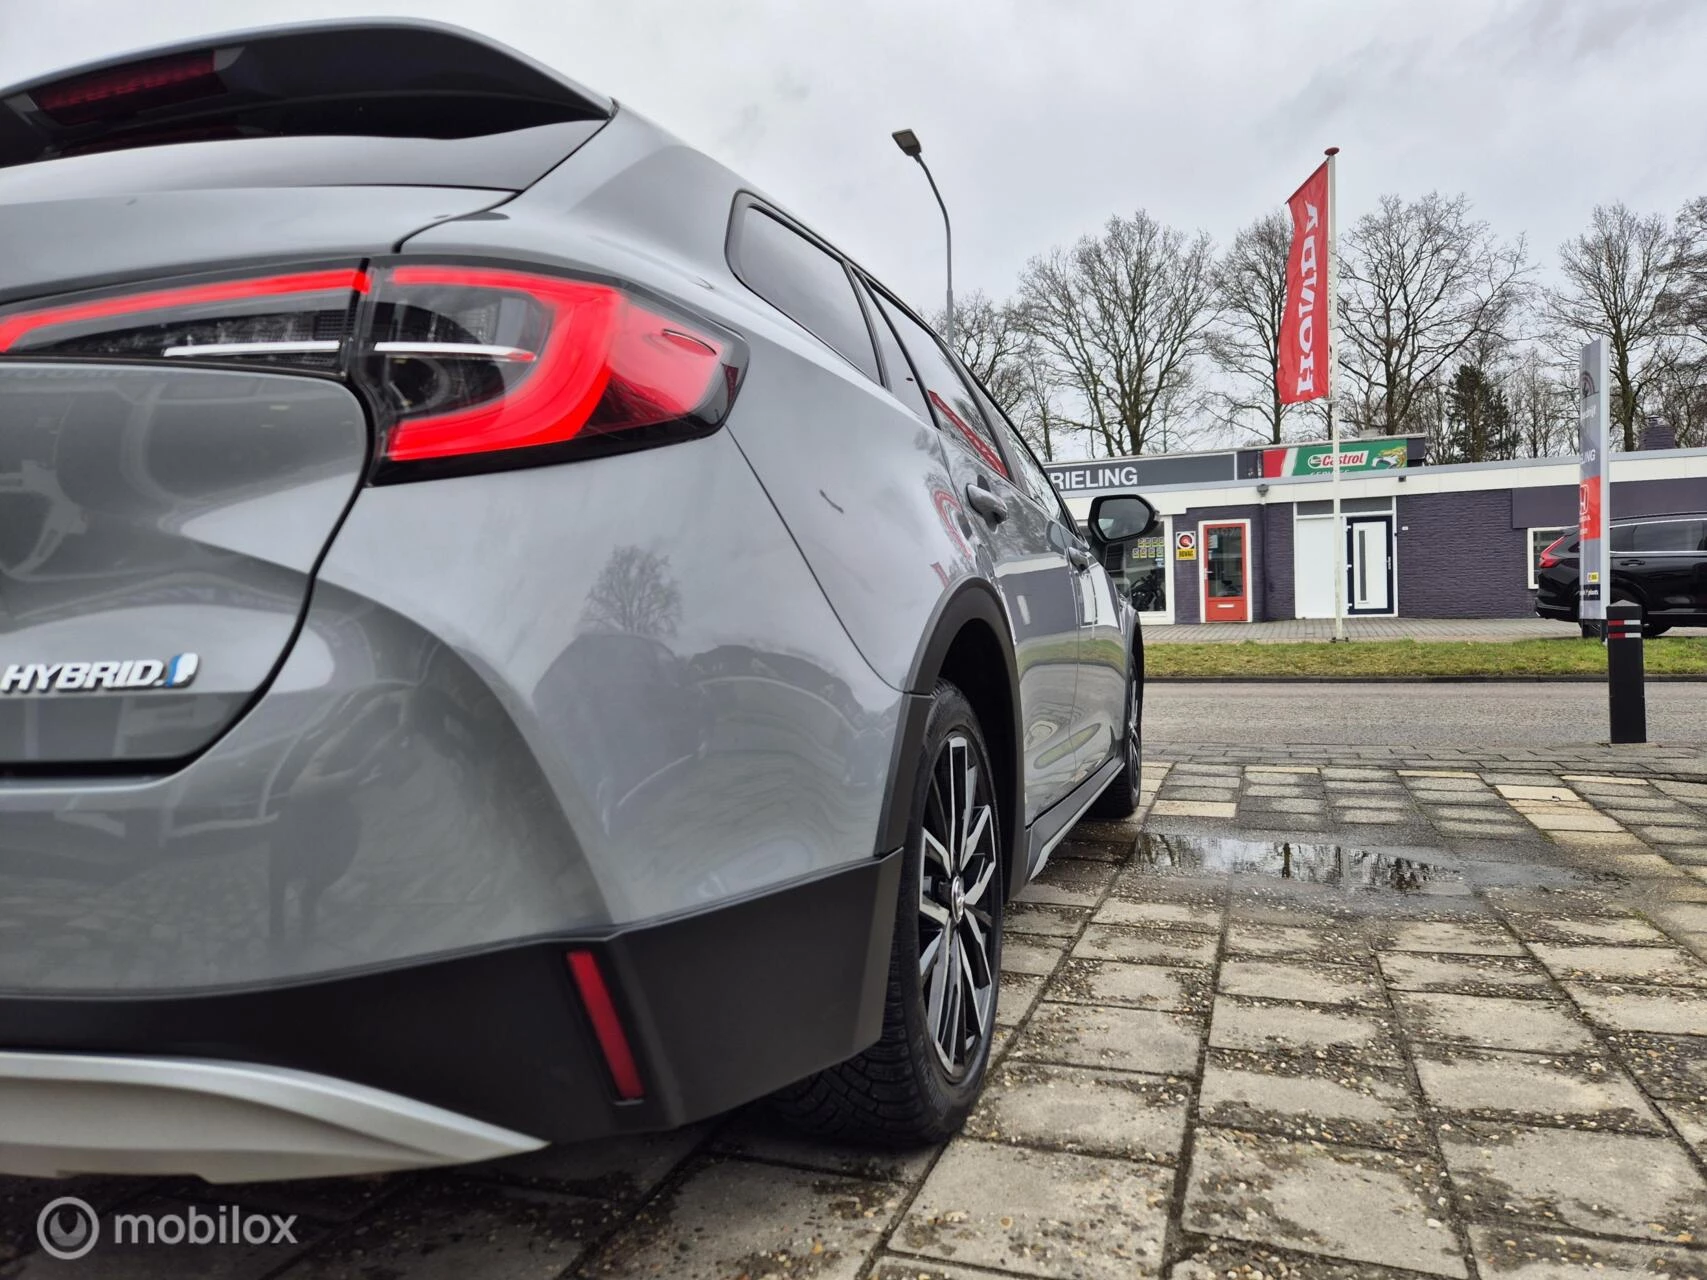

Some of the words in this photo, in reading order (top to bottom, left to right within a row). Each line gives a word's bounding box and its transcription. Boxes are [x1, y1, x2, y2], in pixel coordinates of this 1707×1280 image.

[1297, 201, 1318, 394] HONDA
[1048, 466, 1138, 490] RIELING
[1, 660, 164, 692] HYBRID
